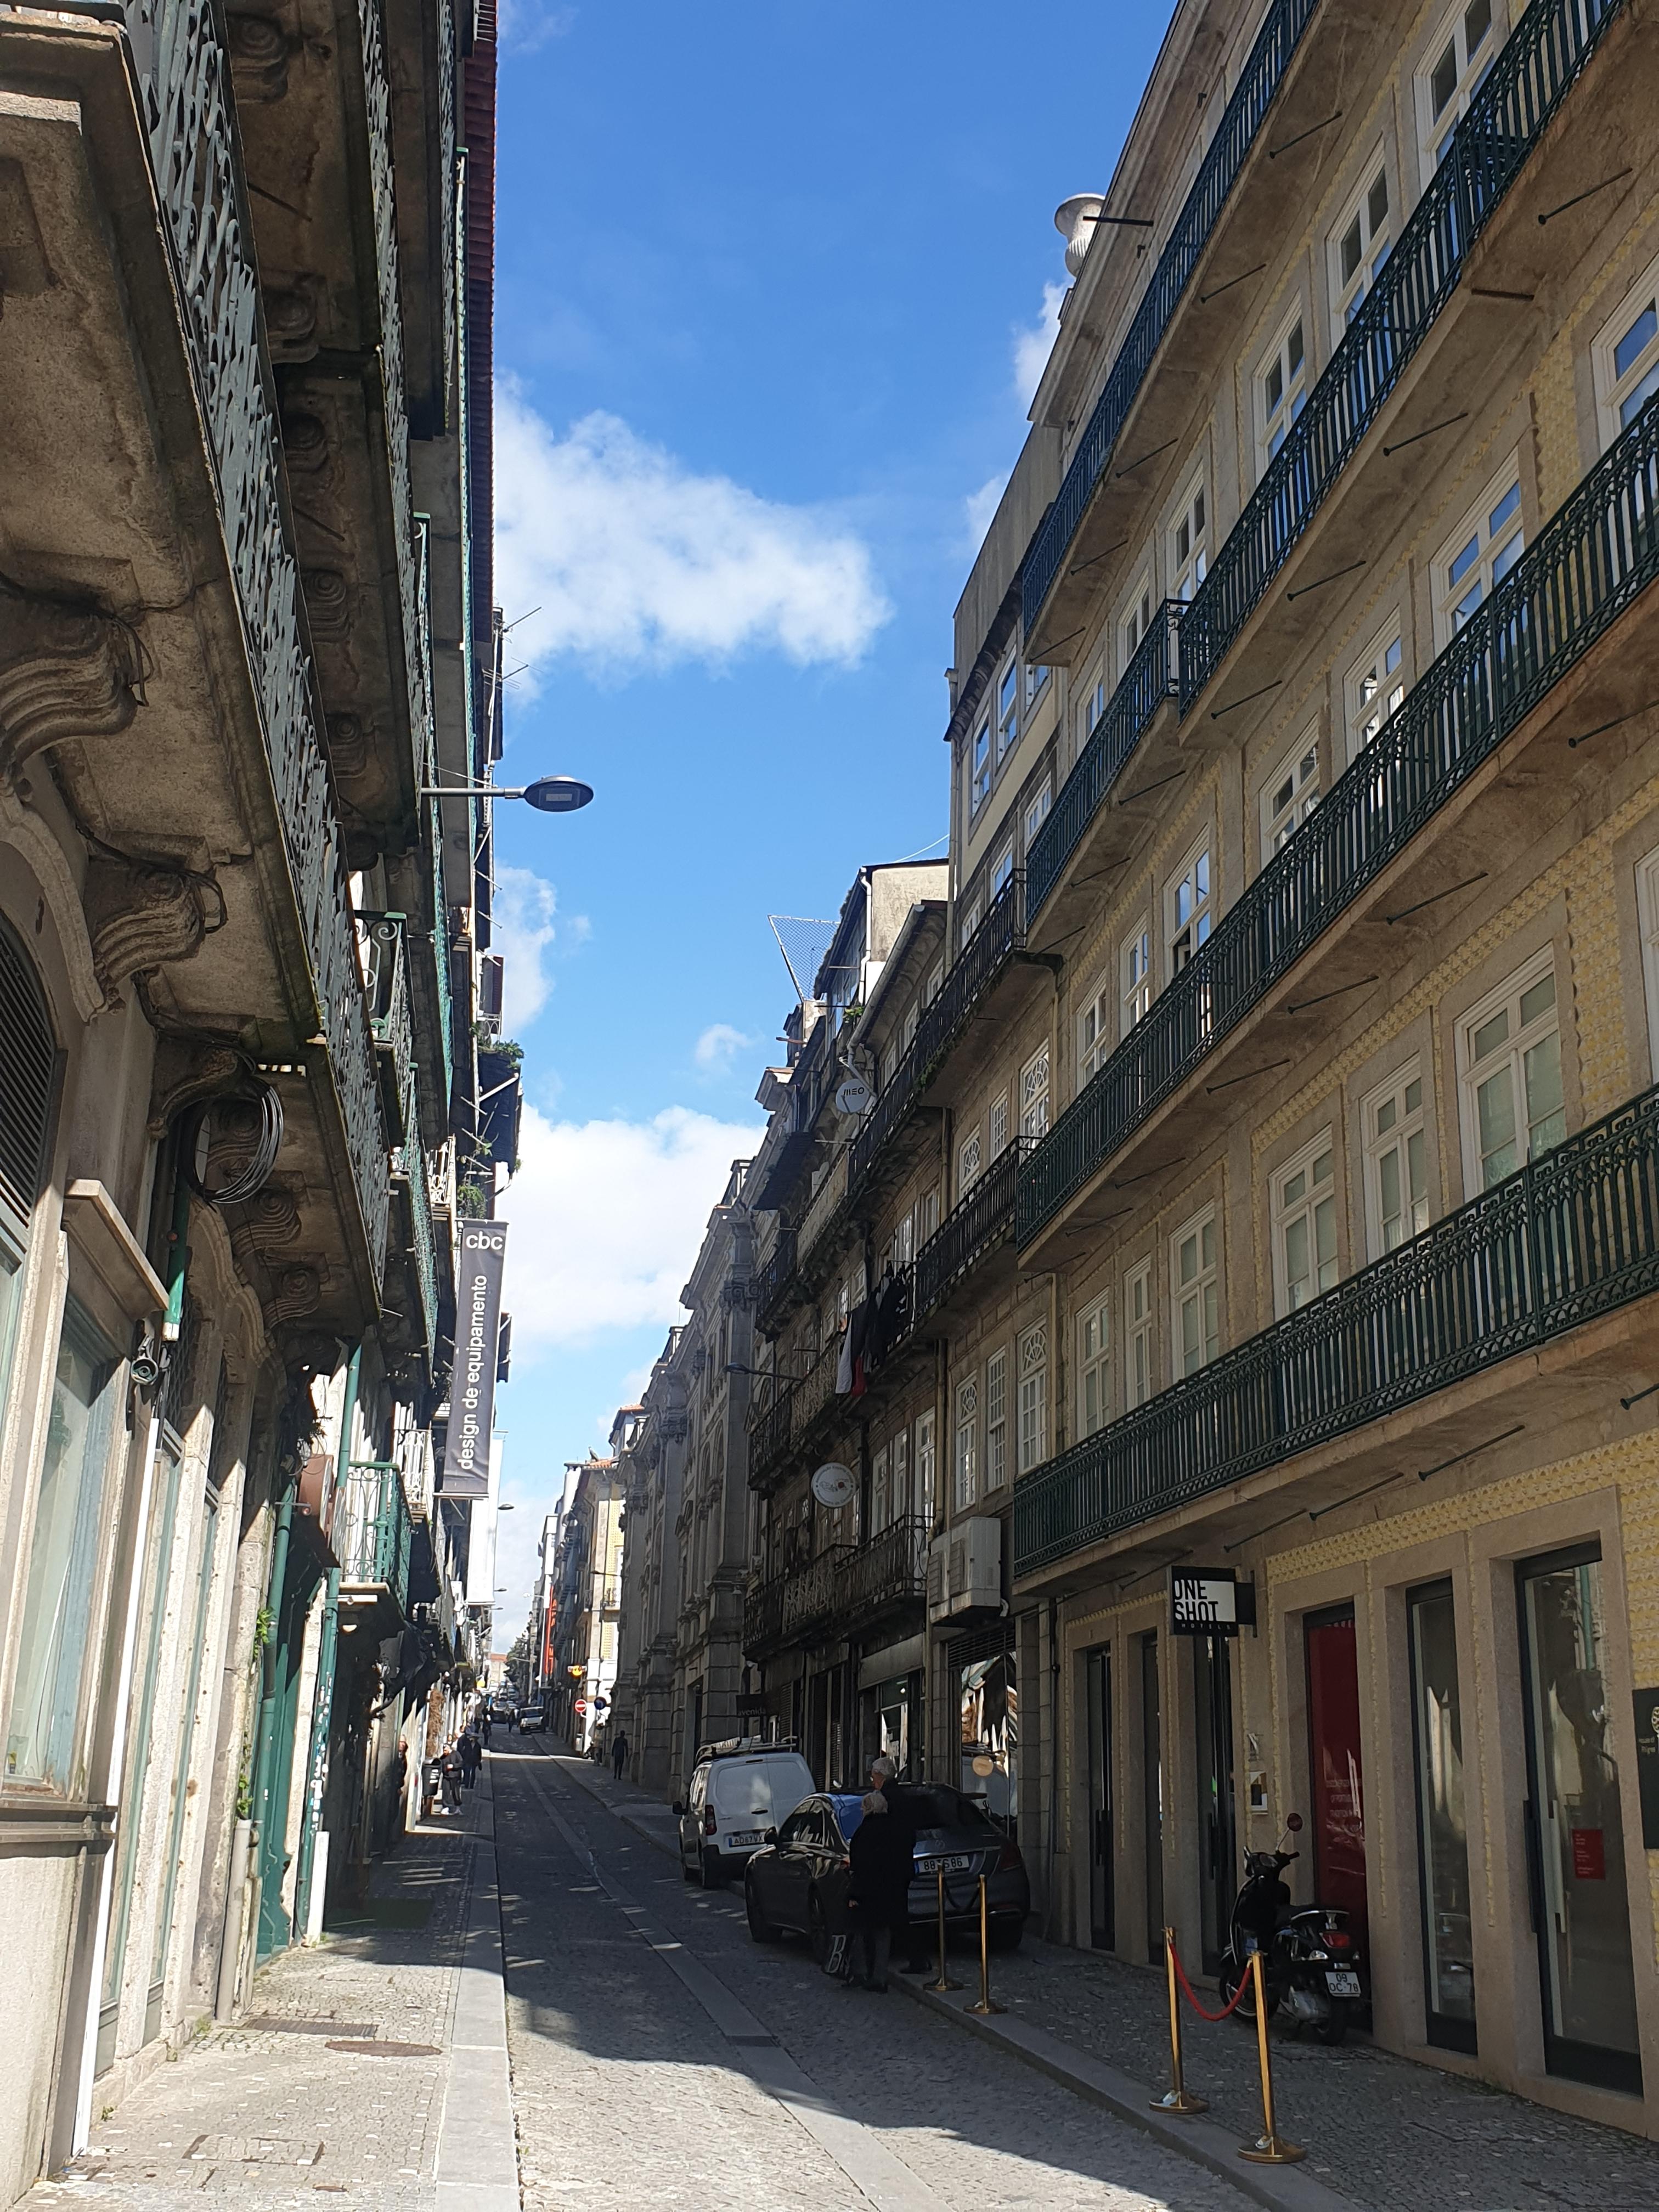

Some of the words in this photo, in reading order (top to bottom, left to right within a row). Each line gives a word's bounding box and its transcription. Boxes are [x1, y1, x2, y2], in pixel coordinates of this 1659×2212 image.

[843, 1087, 865, 1096] MEO
[466, 1231, 503, 1250] cbc
[466, 1274, 487, 1383] equipamento
[461, 1389, 478, 1408] de
[457, 1414, 477, 1470] design
[1174, 1579, 1207, 1600] ONE
[1174, 1601, 1218, 1621] SHOT
[1336, 1973, 1348, 1983] 09
